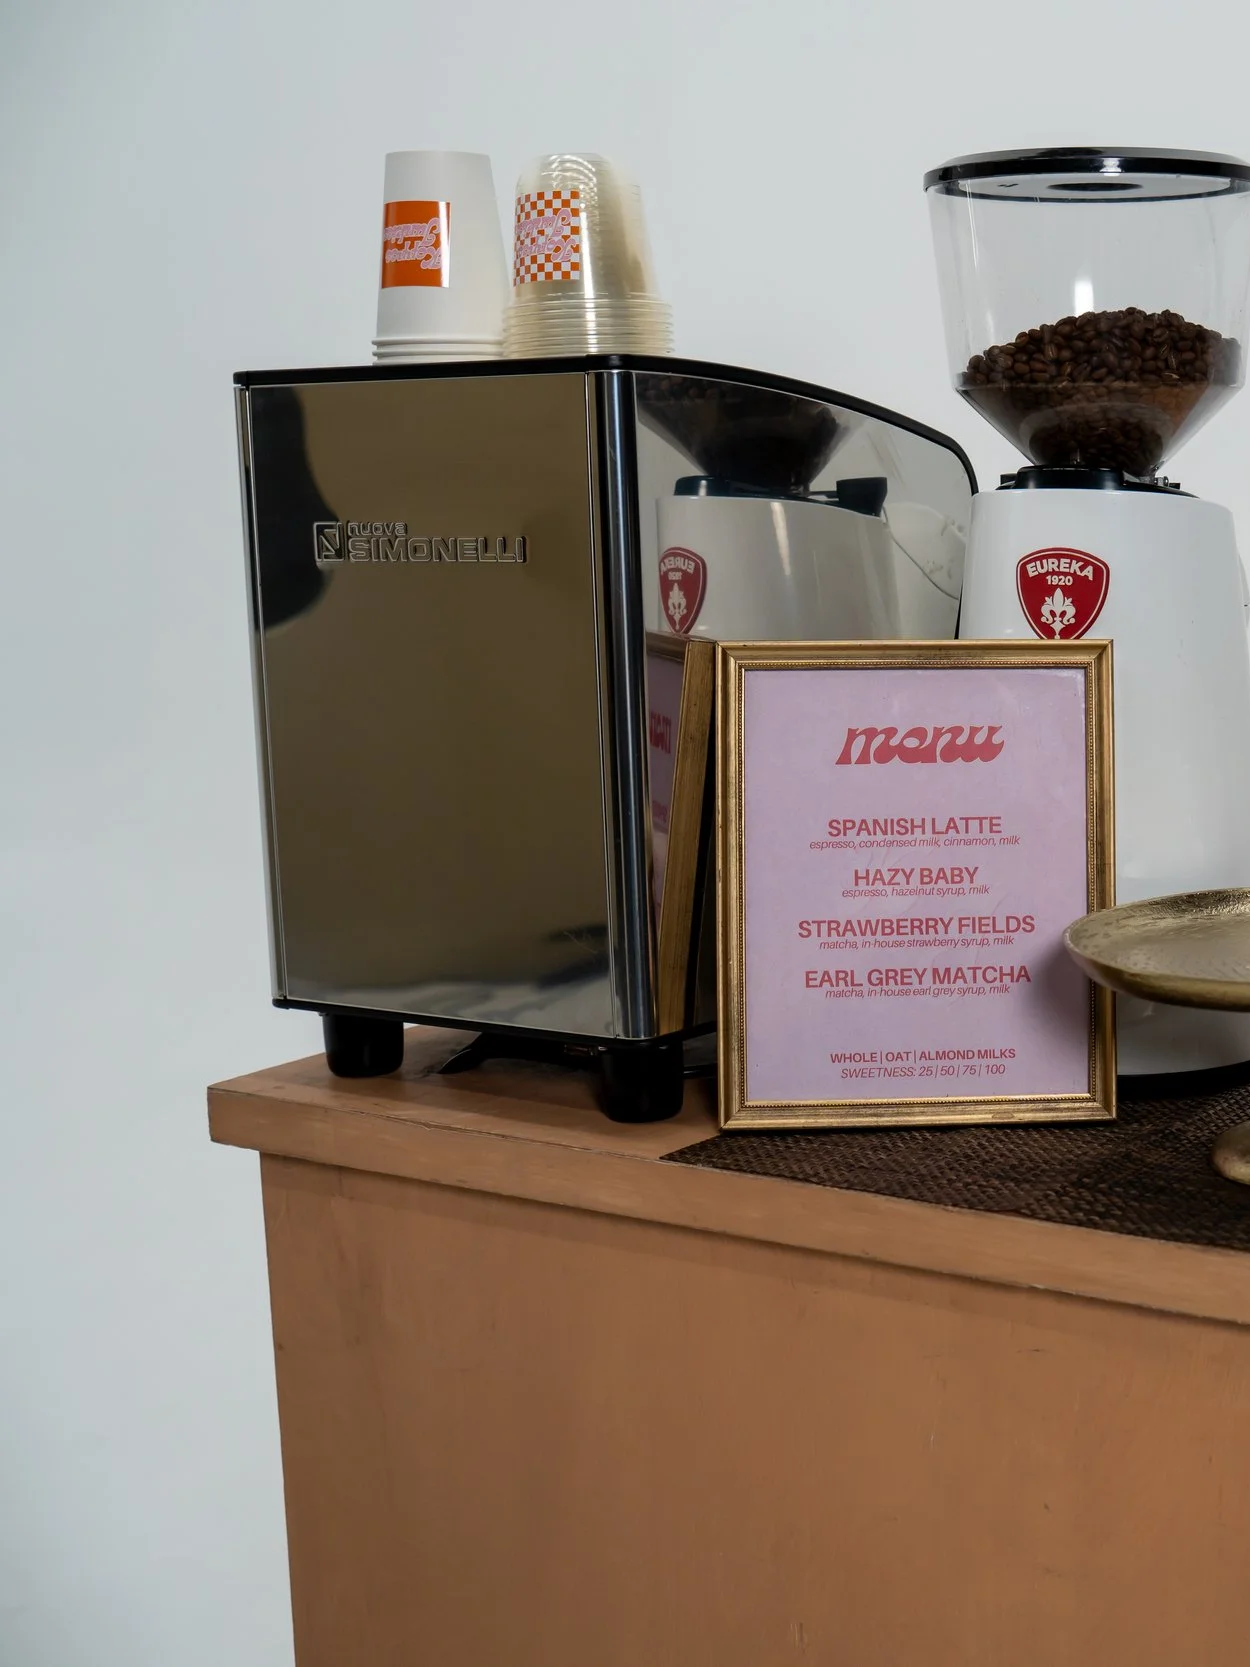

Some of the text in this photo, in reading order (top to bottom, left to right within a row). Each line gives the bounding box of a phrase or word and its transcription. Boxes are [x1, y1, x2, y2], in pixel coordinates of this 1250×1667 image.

[348, 537, 526, 563] SIMONELLI
[1026, 558, 1094, 581] EUREKA
[1046, 575, 1073, 586] 1920
[835, 725, 1005, 765] menu
[828, 816, 1002, 837] SPANISH LATTE
[809, 835, 1020, 851] espresso, condensed milk, cinnamon, milk
[854, 866, 979, 887] HAZY BABY
[842, 884, 991, 899] espresso, hazelnut syrup, milk
[798, 915, 1035, 938] STRAWBERRY FIELDS
[819, 935, 1014, 950] matcha, in-house strawberry syrup, milk
[805, 965, 1032, 988] EARL GREY MATCHA
[825, 984, 1011, 999] matcha, in-house earl grey syrup, milk
[830, 1051, 878, 1064] WHOLE
[885, 1051, 912, 1062] OAT
[919, 1049, 975, 1061] ALMOND
[977, 1048, 1016, 1060] MILKS
[841, 1066, 916, 1079] SWEETNESS:
[918, 1066, 934, 1077] 25
[940, 1065, 955, 1076] 50
[962, 1065, 976, 1076] 75
[984, 1063, 1006, 1075] 100
